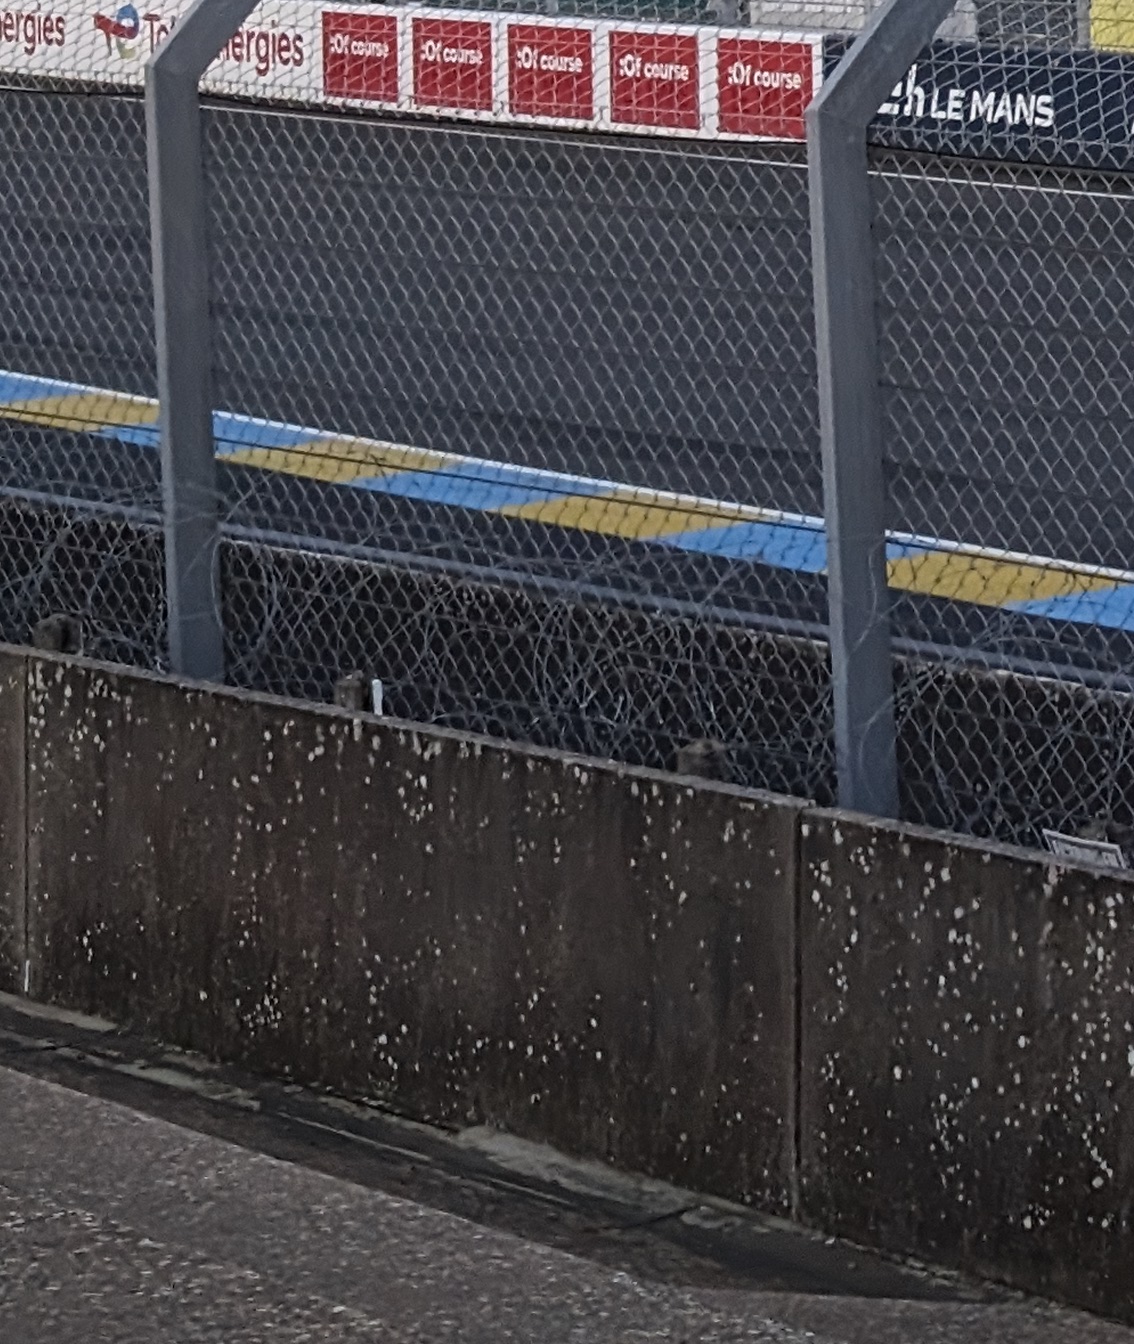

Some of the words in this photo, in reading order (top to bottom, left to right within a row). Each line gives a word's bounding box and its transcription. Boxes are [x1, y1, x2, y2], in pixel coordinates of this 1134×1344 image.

[0, 3, 66, 56] ergies
[350, 39, 389, 57] course
[443, 47, 483, 65] course
[540, 54, 583, 73] course
[643, 62, 689, 81] course
[753, 71, 802, 90] course
[930, 87, 967, 121] LE
[969, 90, 1055, 128] MANS
